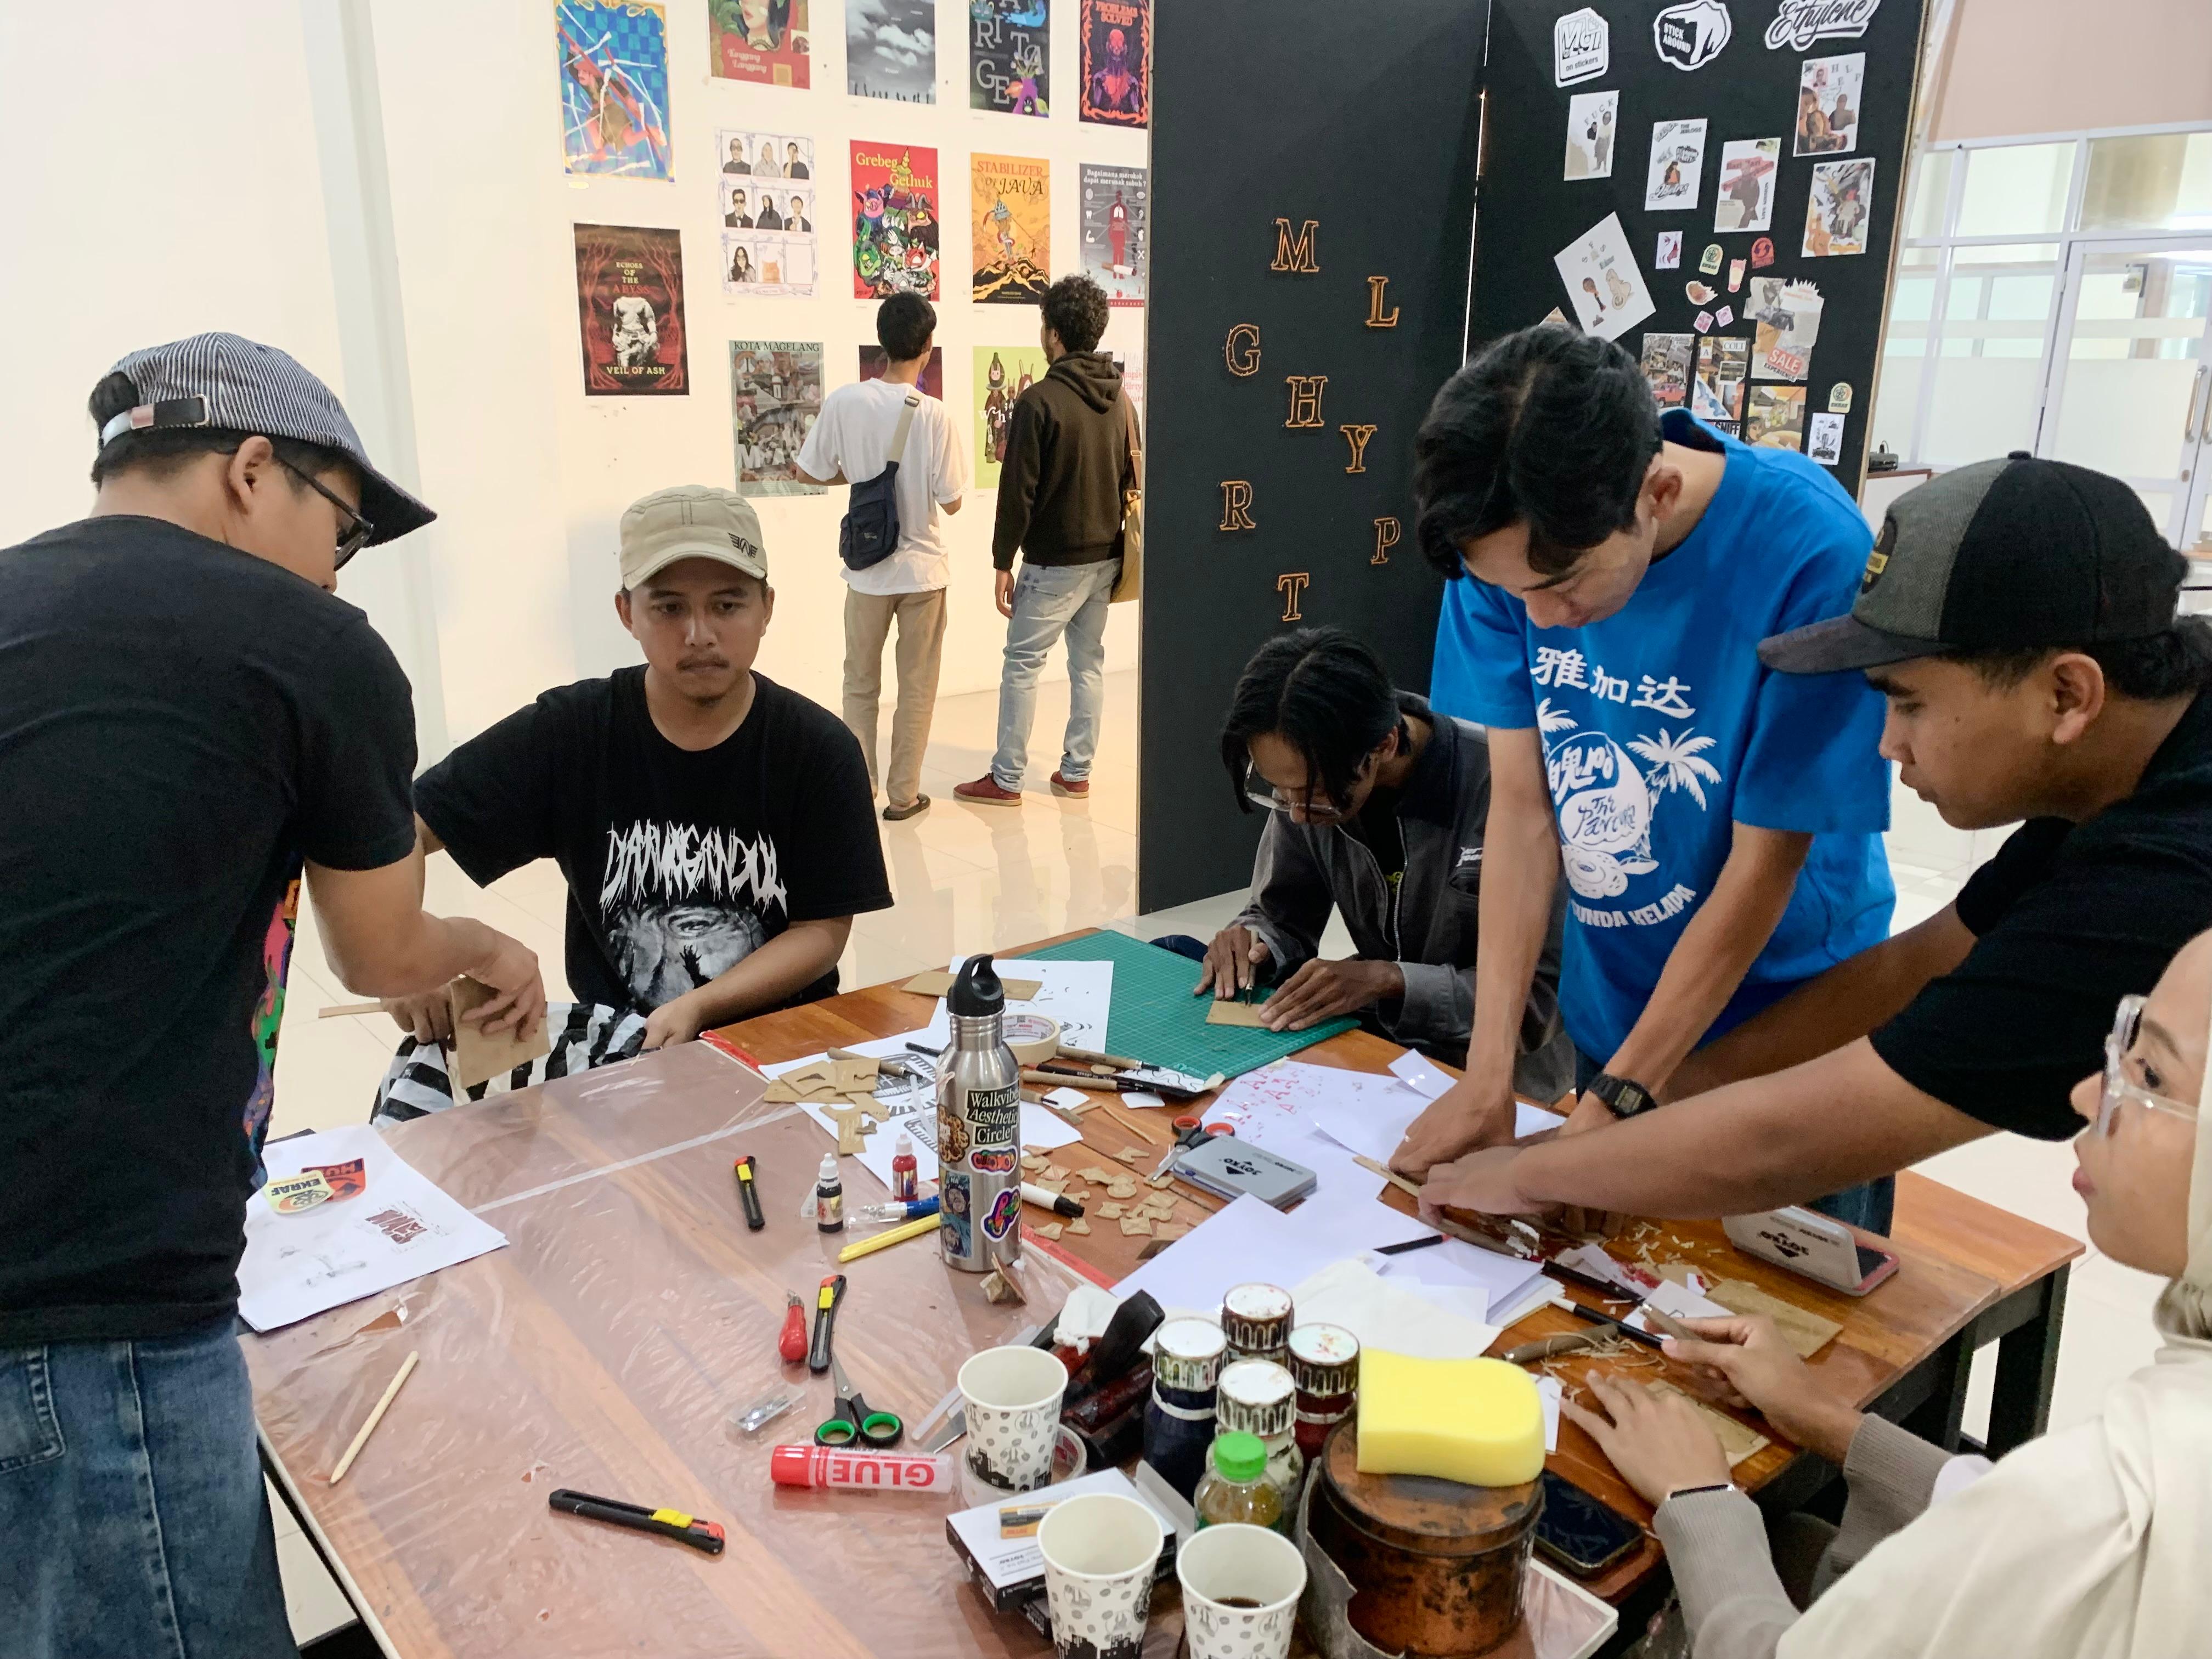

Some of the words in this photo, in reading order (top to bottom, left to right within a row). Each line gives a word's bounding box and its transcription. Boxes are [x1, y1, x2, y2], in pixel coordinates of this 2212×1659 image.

[1096, 1, 1138, 18] PROBLEMS
[1101, 11, 1133, 26] SOLVED
[1663, 22, 1684, 40] STICK
[1769, 0, 1875, 47] Ethylene
[1662, 34, 1691, 53] AROUND
[1575, 57, 1598, 69] stickers
[856, 152, 898, 172] Grebeg
[977, 161, 1043, 177] STABILIZER
[889, 173, 933, 189] Gethuk
[1087, 169, 1118, 178] Bagaimana
[998, 177, 1043, 195] JAVA
[1271, 218, 1319, 272] M
[613, 284, 650, 294] ABYSS
[621, 276, 639, 284] THE
[1365, 276, 1399, 328] L
[734, 341, 760, 351] KOTA
[763, 342, 819, 352] MAGELANG
[1225, 324, 1261, 376] G
[606, 366, 629, 375] VEIL
[646, 366, 665, 375] ASH
[1769, 349, 1801, 374] SALE
[1763, 363, 1795, 381] EXPERIENCE
[1285, 376, 1328, 427] H
[1339, 425, 1377, 473] Y
[1218, 480, 1256, 531] R
[1370, 517, 1400, 565] P
[1277, 572, 1309, 622] T
[1530, 646, 1695, 719] 雅加达
[1627, 883, 1696, 926] KELAPA
[970, 1087, 1019, 1108] Walkvibe
[969, 1108, 1018, 1125] Aesthetic
[977, 1125, 1011, 1143] Circle
[1223, 1158, 1262, 1176] JOYKO
[271, 1178, 321, 1197] EKRAF
[832, 1459, 935, 1487] GLUE
